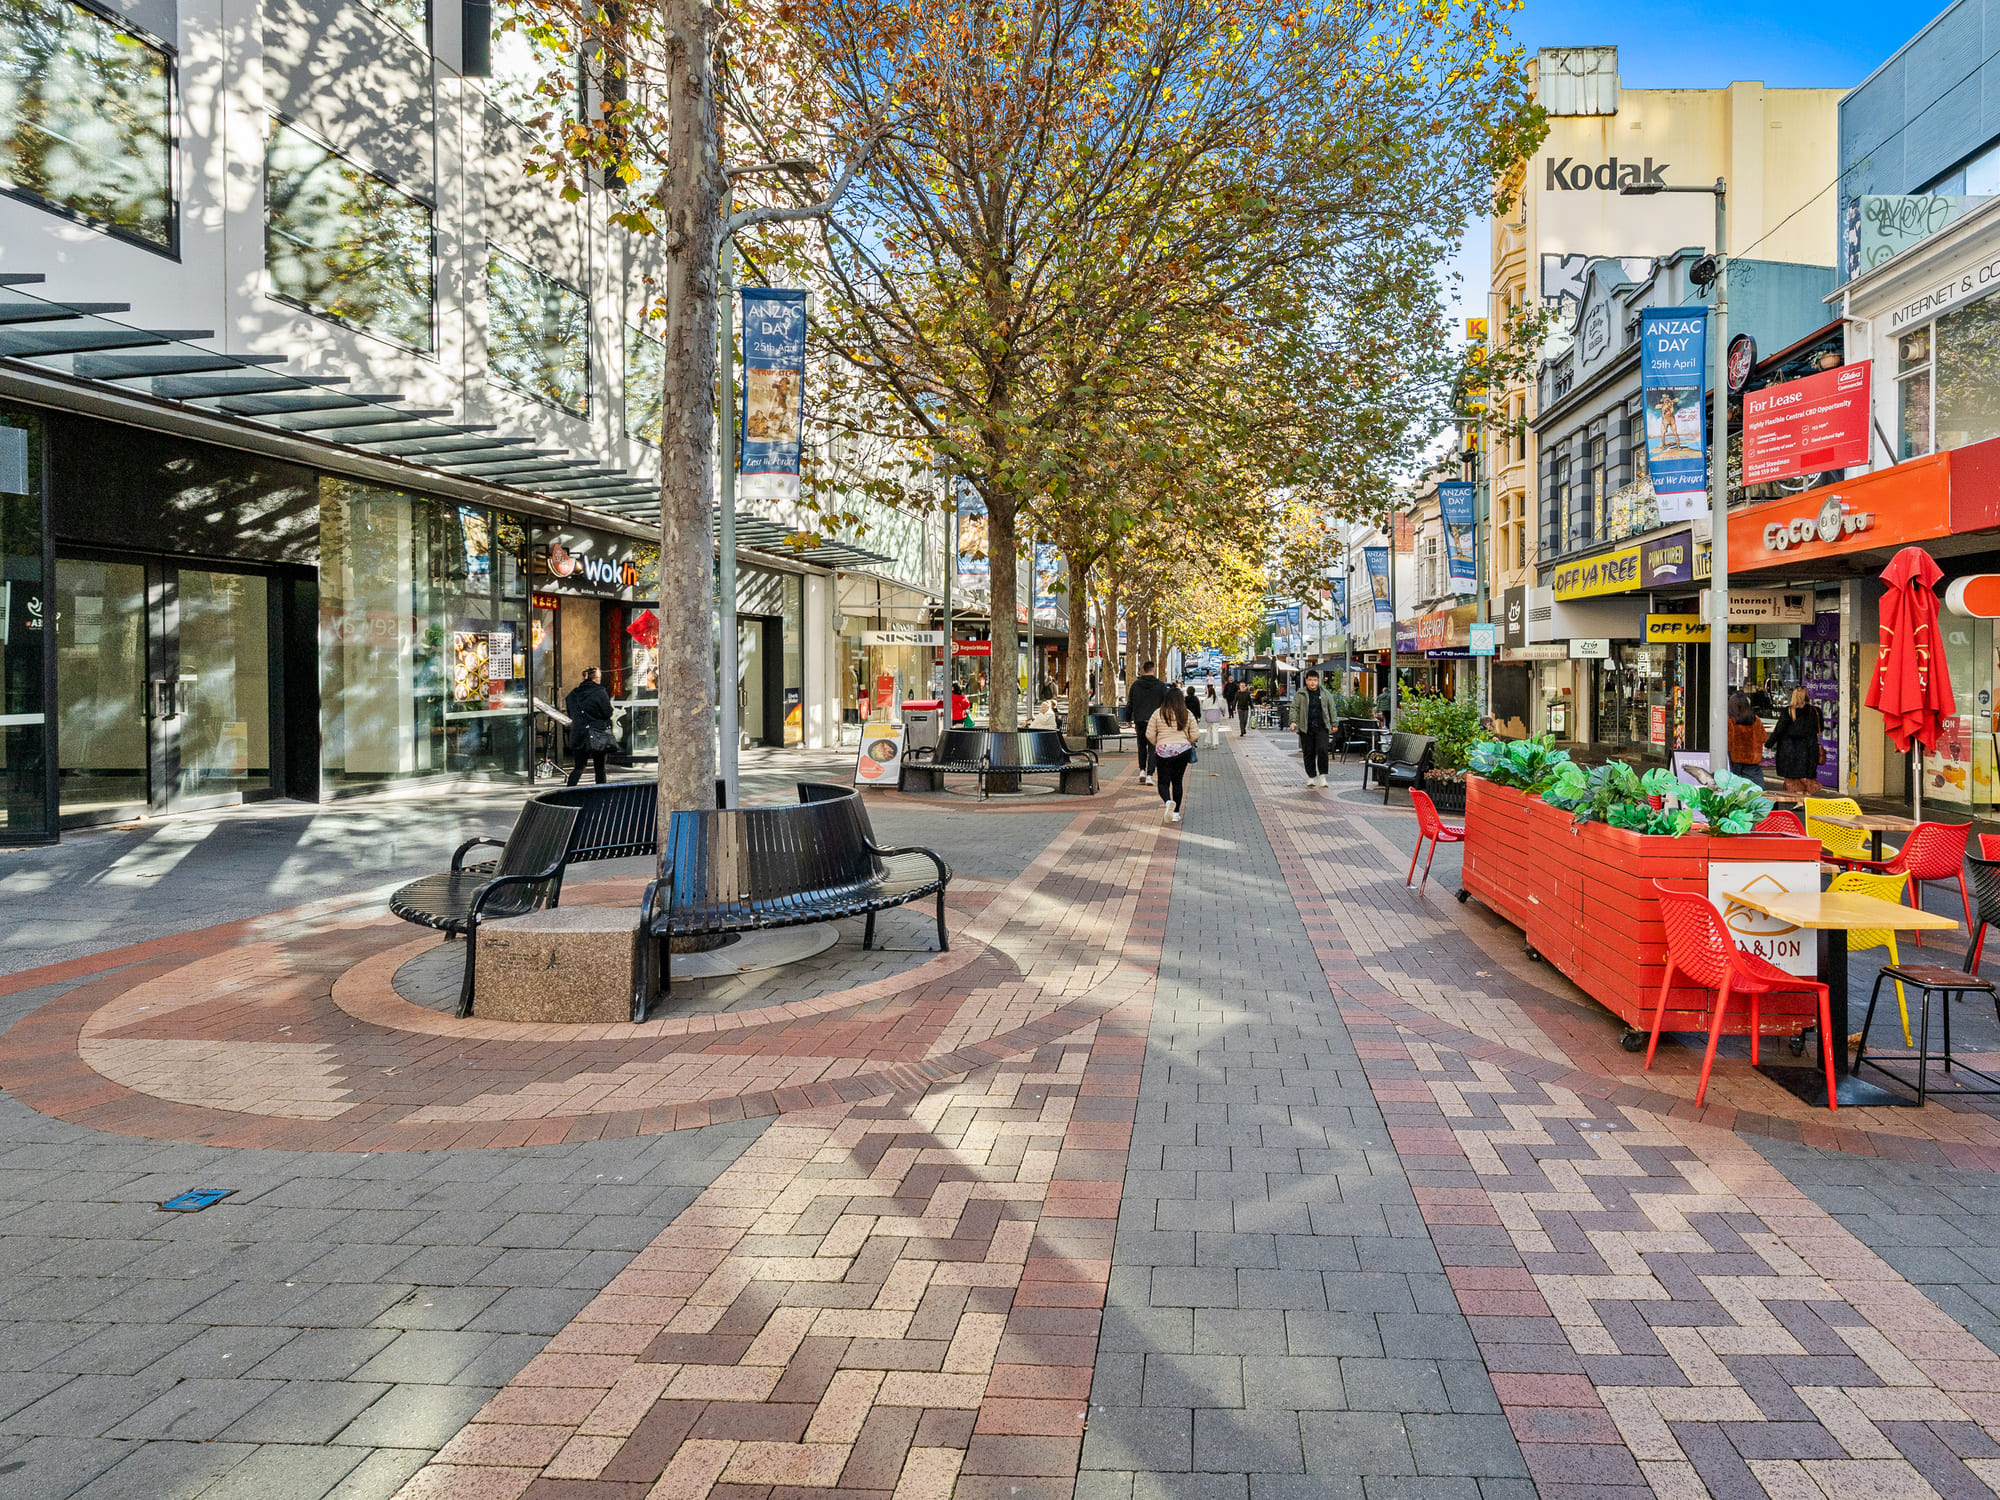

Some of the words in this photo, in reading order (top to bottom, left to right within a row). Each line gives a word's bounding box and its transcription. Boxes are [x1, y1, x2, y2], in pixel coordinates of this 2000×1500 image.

[1546, 157, 1671, 191] Kodak
[1892, 282, 1956, 326] INTERNET
[1961, 275, 1973, 292] &
[748, 304, 801, 319] ANZAC
[761, 322, 791, 335] DAY
[1646, 320, 1702, 335] ANZAC
[753, 342, 775, 352] 25th
[779, 341, 797, 354] April
[1658, 338, 1689, 352] DAY
[1651, 359, 1671, 369] 25th
[1673, 358, 1696, 370] April
[1749, 400, 1767, 414] For
[1769, 392, 1803, 409] Lease
[1749, 420, 1765, 430] Highly
[1765, 415, 1785, 426] Flexible
[1785, 410, 1805, 421] Central
[1805, 408, 1817, 416] CBD
[1817, 400, 1852, 413] Opportunity
[1748, 462, 1766, 471] Richard
[1666, 476, 1678, 485] We
[1679, 474, 1704, 485] Forget
[1441, 488, 1471, 497] ANZAC
[1448, 497, 1465, 505] DAY
[1648, 544, 1684, 570] PUNKTURED
[1556, 569, 1579, 593] OFF
[1581, 564, 1599, 591] YA
[1601, 555, 1639, 586] TREE
[1730, 597, 1772, 605] Internet
[1729, 607, 1767, 615] Lounge
[1419, 616, 1446, 642] Caseway
[1650, 623, 1682, 634] OFF
[1685, 623, 1707, 634] YA
[876, 633, 934, 643] sussan
[1807, 682, 1819, 690] Body
[1819, 681, 1839, 691] Piercing
